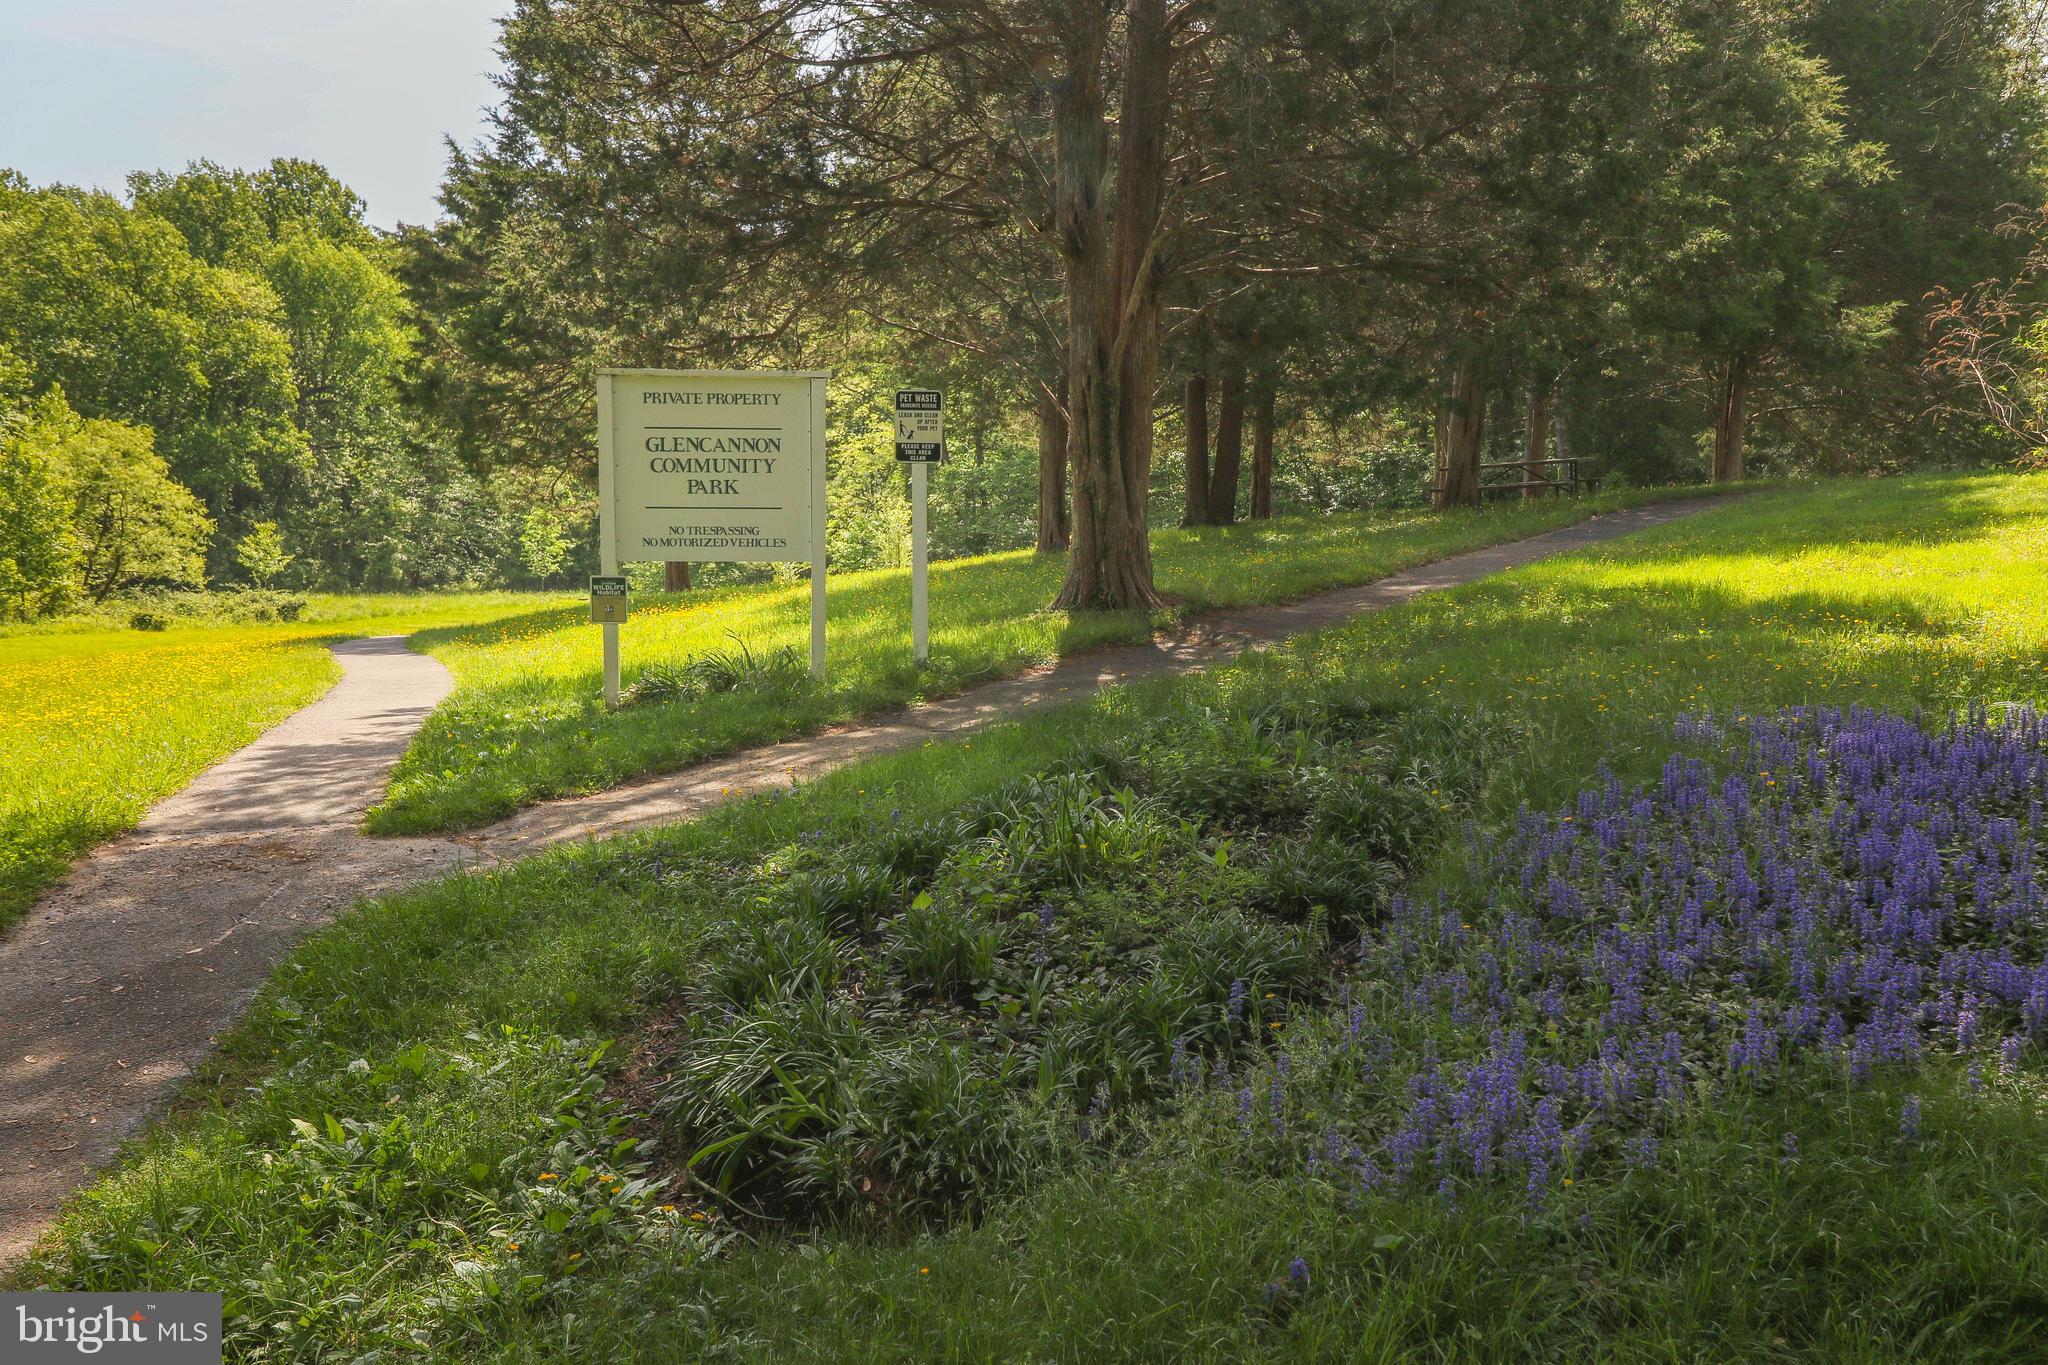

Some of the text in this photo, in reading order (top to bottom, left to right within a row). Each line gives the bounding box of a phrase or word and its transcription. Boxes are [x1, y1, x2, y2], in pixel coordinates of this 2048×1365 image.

[643, 392, 782, 405] PRIVATE PROPERTY
[900, 394, 938, 402] PET WASTE
[645, 436, 782, 453] GLENCANNON
[650, 458, 776, 473] COMMUNITY
[687, 480, 740, 494] PARK
[669, 526, 760, 536] NO TRESPASSING
[642, 537, 787, 548] NO MOTORIZED VEHICLES
